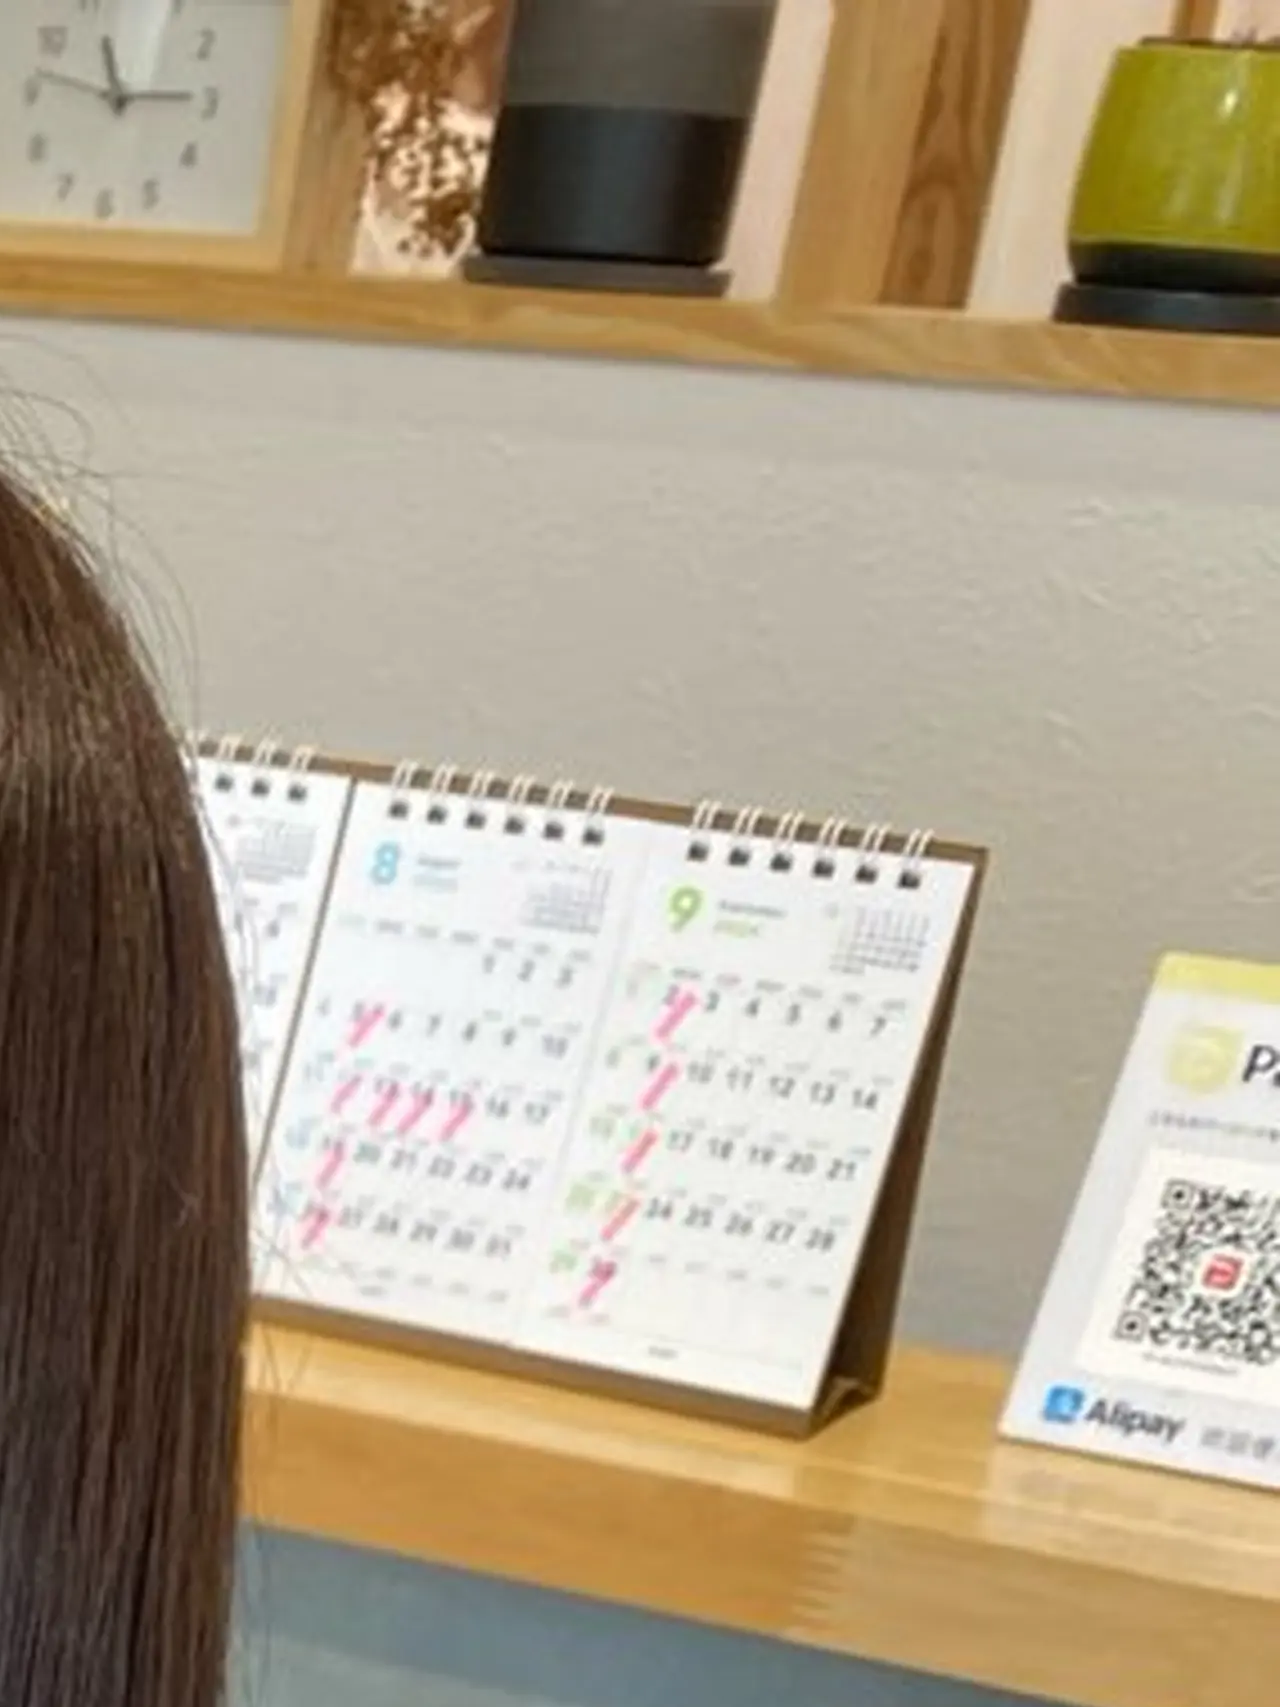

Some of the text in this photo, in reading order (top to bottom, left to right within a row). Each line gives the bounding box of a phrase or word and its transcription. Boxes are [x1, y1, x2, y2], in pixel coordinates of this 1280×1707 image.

[370, 841, 401, 886] 8
[667, 885, 702, 934] 9
[1241, 1043, 1280, 1088] P
[1085, 1397, 1188, 1444] Alipay
